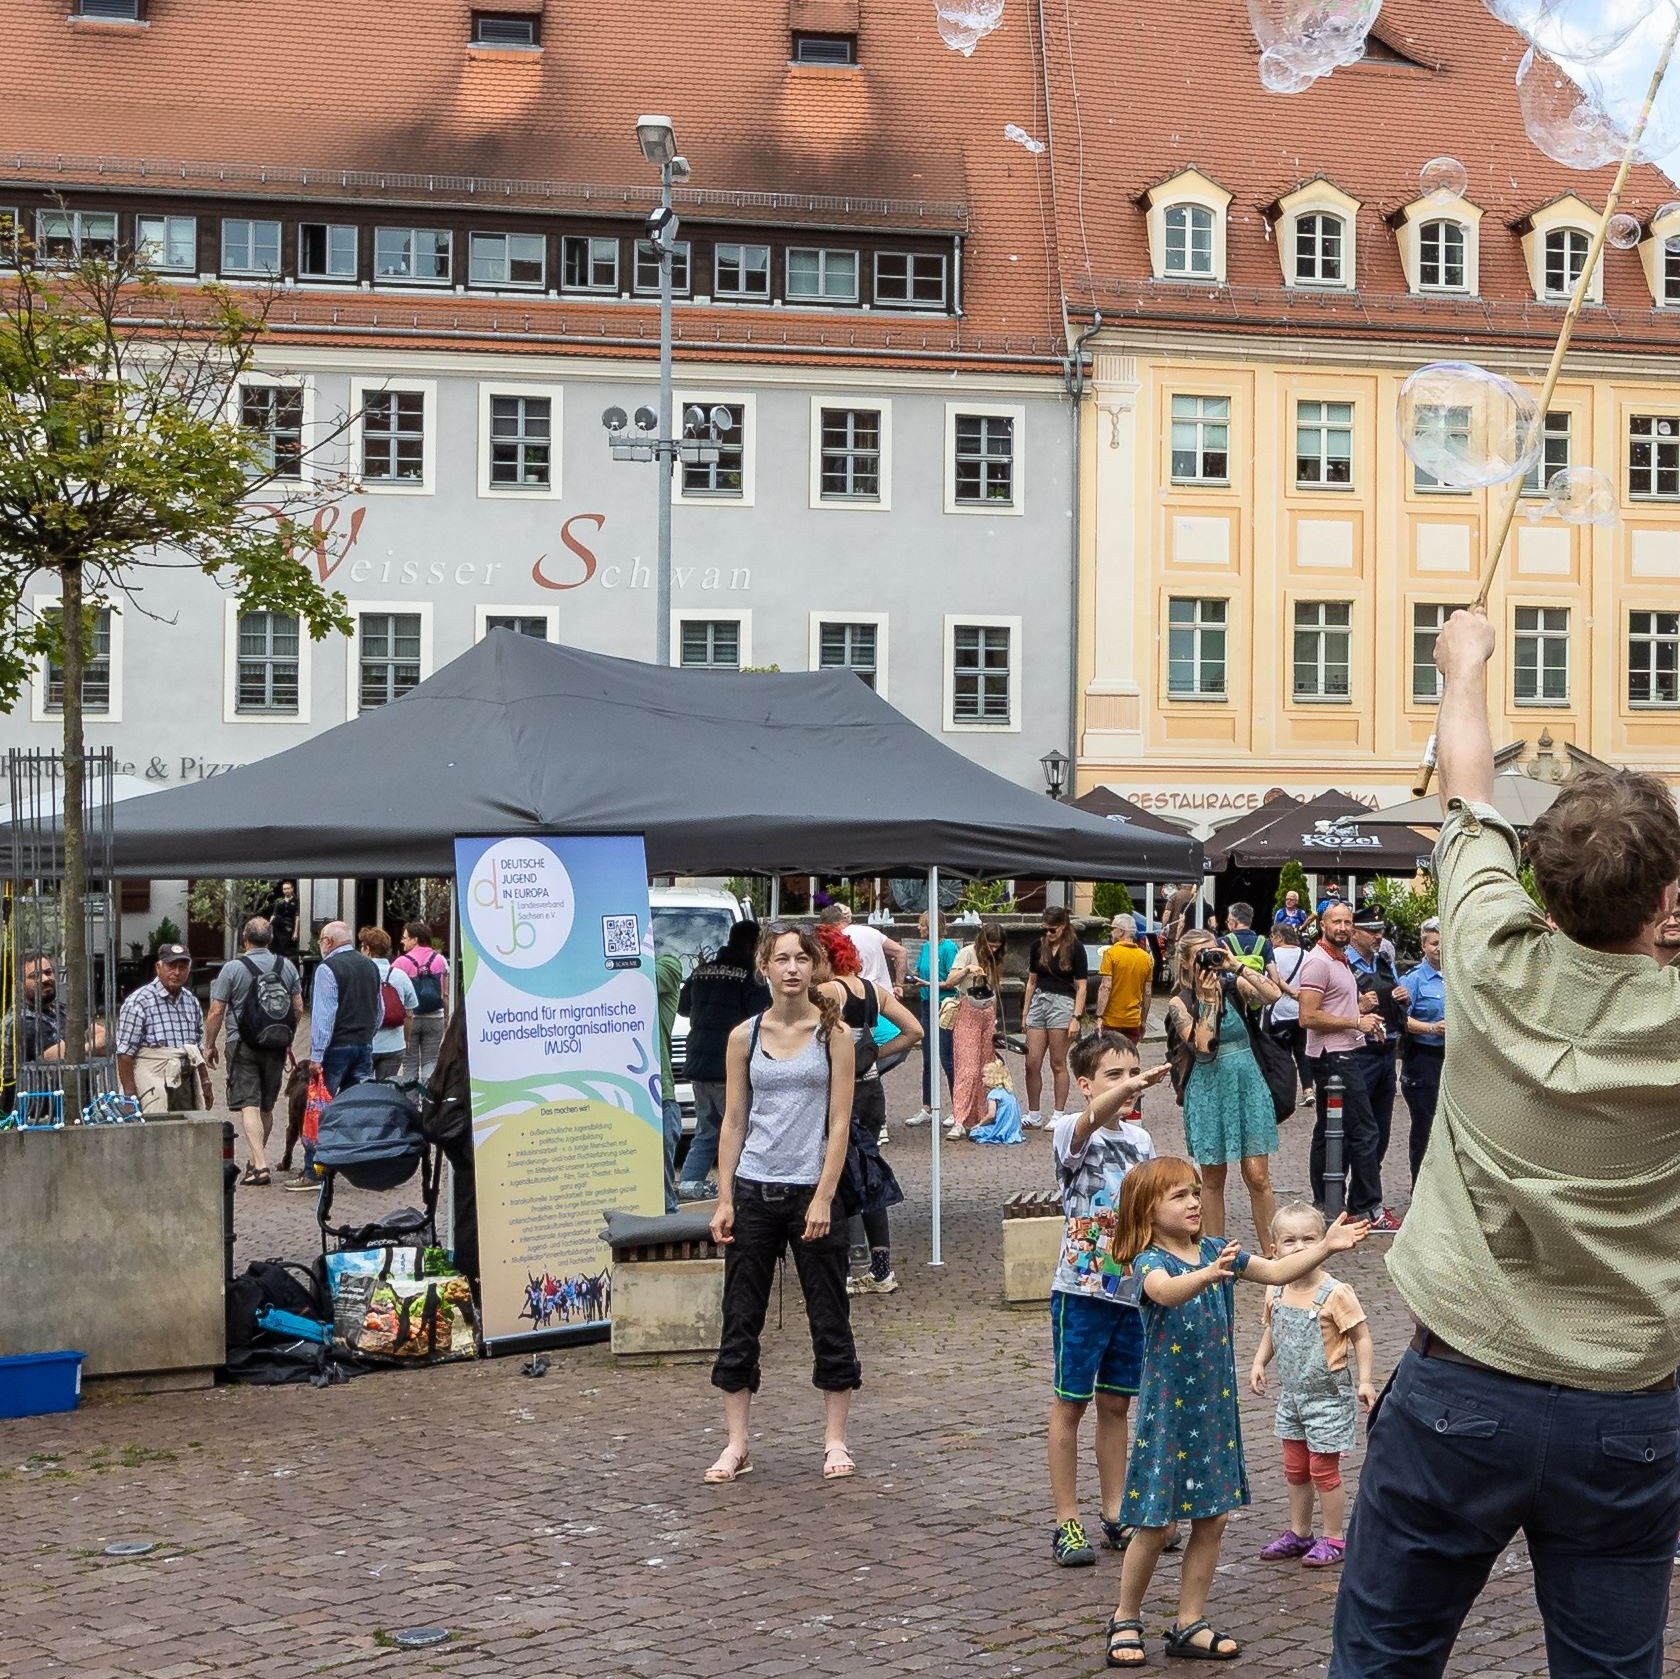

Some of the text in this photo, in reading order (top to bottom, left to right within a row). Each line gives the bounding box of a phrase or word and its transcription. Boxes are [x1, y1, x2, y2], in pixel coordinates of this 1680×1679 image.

[532, 513, 754, 591] Schwan
[145, 756, 169, 779] &
[1127, 792, 1259, 811] RESTAURACE
[1301, 834, 1383, 848] Kozel
[501, 857, 545, 869] DEUTSCHE
[502, 873, 537, 884] JUGEND
[503, 887, 549, 899] IN EUROPA
[518, 911, 544, 920] Sachsen
[487, 1001, 636, 1024] Verband für migrantische
[480, 1019, 644, 1045] Jugendselbstorganisationen
[544, 1039, 582, 1055] (MJSO)
[540, 1108, 553, 1116] Das
[554, 1106, 578, 1114] machen
